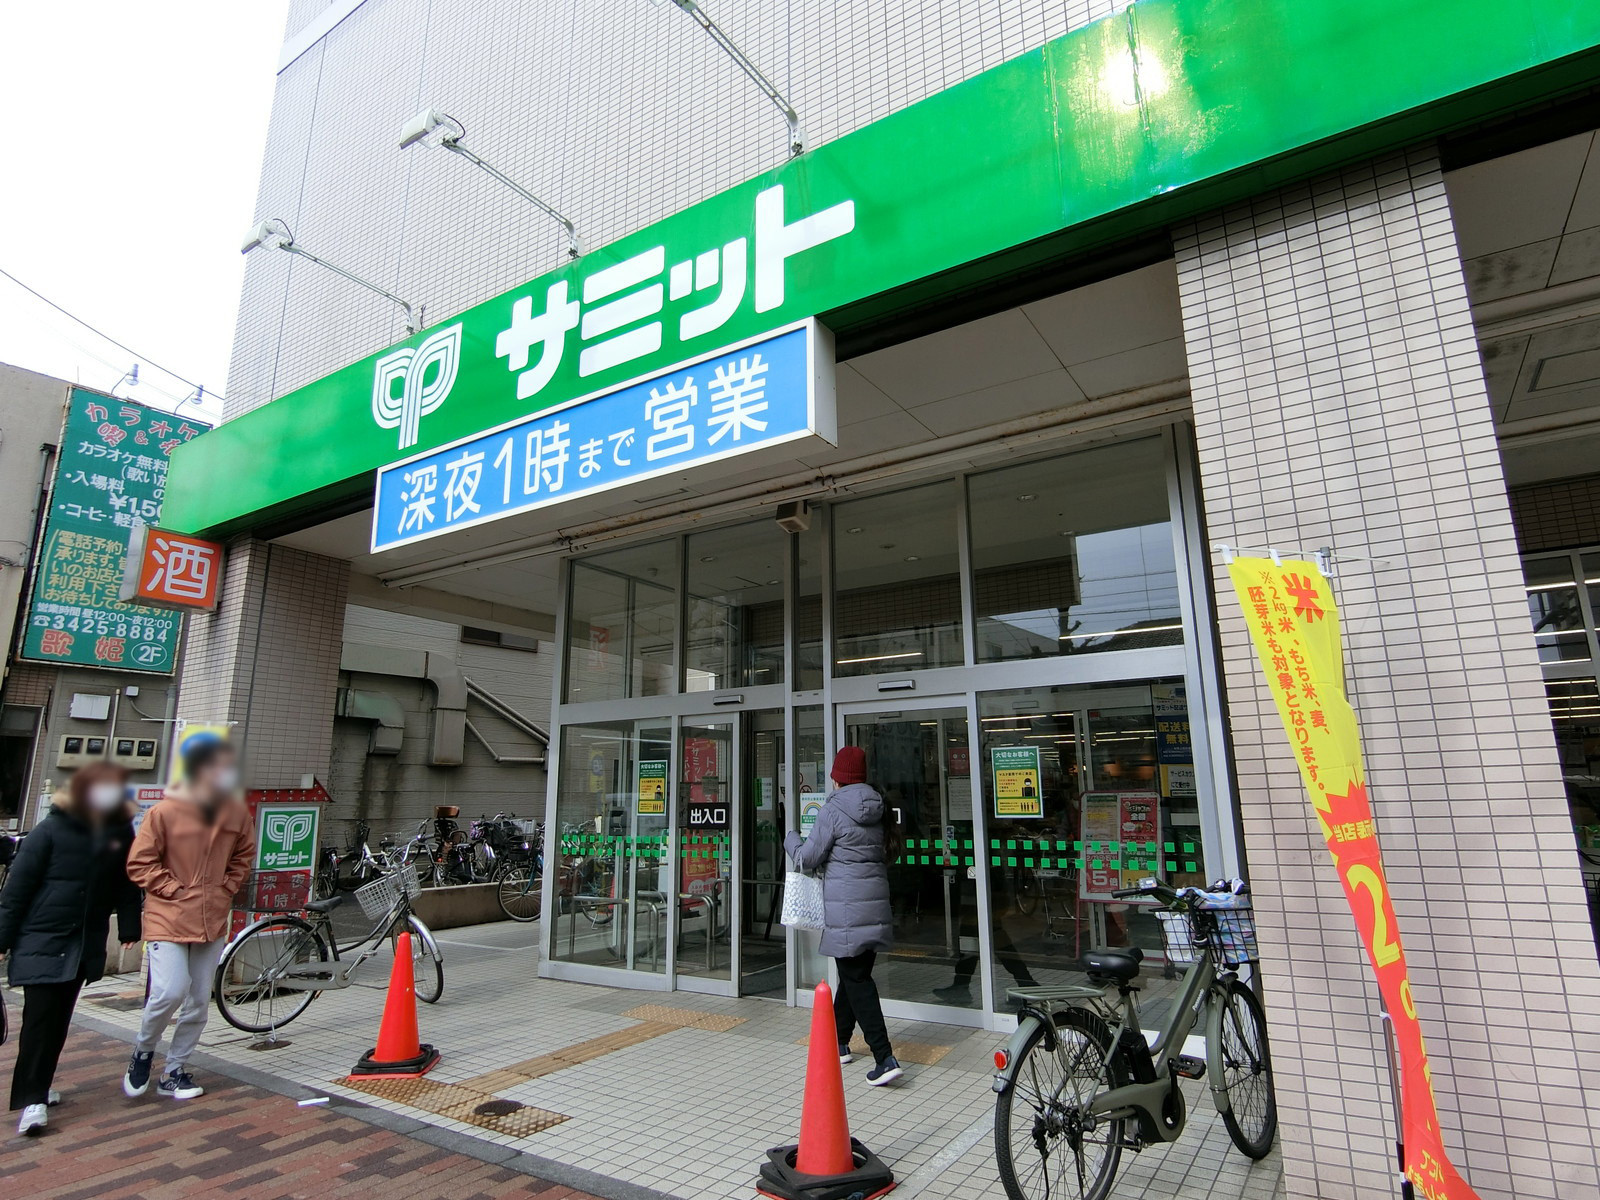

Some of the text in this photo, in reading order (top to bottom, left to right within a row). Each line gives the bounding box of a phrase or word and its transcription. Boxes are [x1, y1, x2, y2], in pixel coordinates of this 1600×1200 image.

[496, 184, 854, 400] サミット
[396, 354, 768, 536] 深夜1時まで営業
[147, 537, 215, 600] 酒
[1281, 572, 1324, 623] 米
[138, 645, 162, 663] 2F
[1247, 586, 1325, 790] 胚芽米も対象となります。
[690, 808, 726, 824] 出入口
[262, 873, 306, 891] 深夜
[264, 851, 309, 866] サミット
